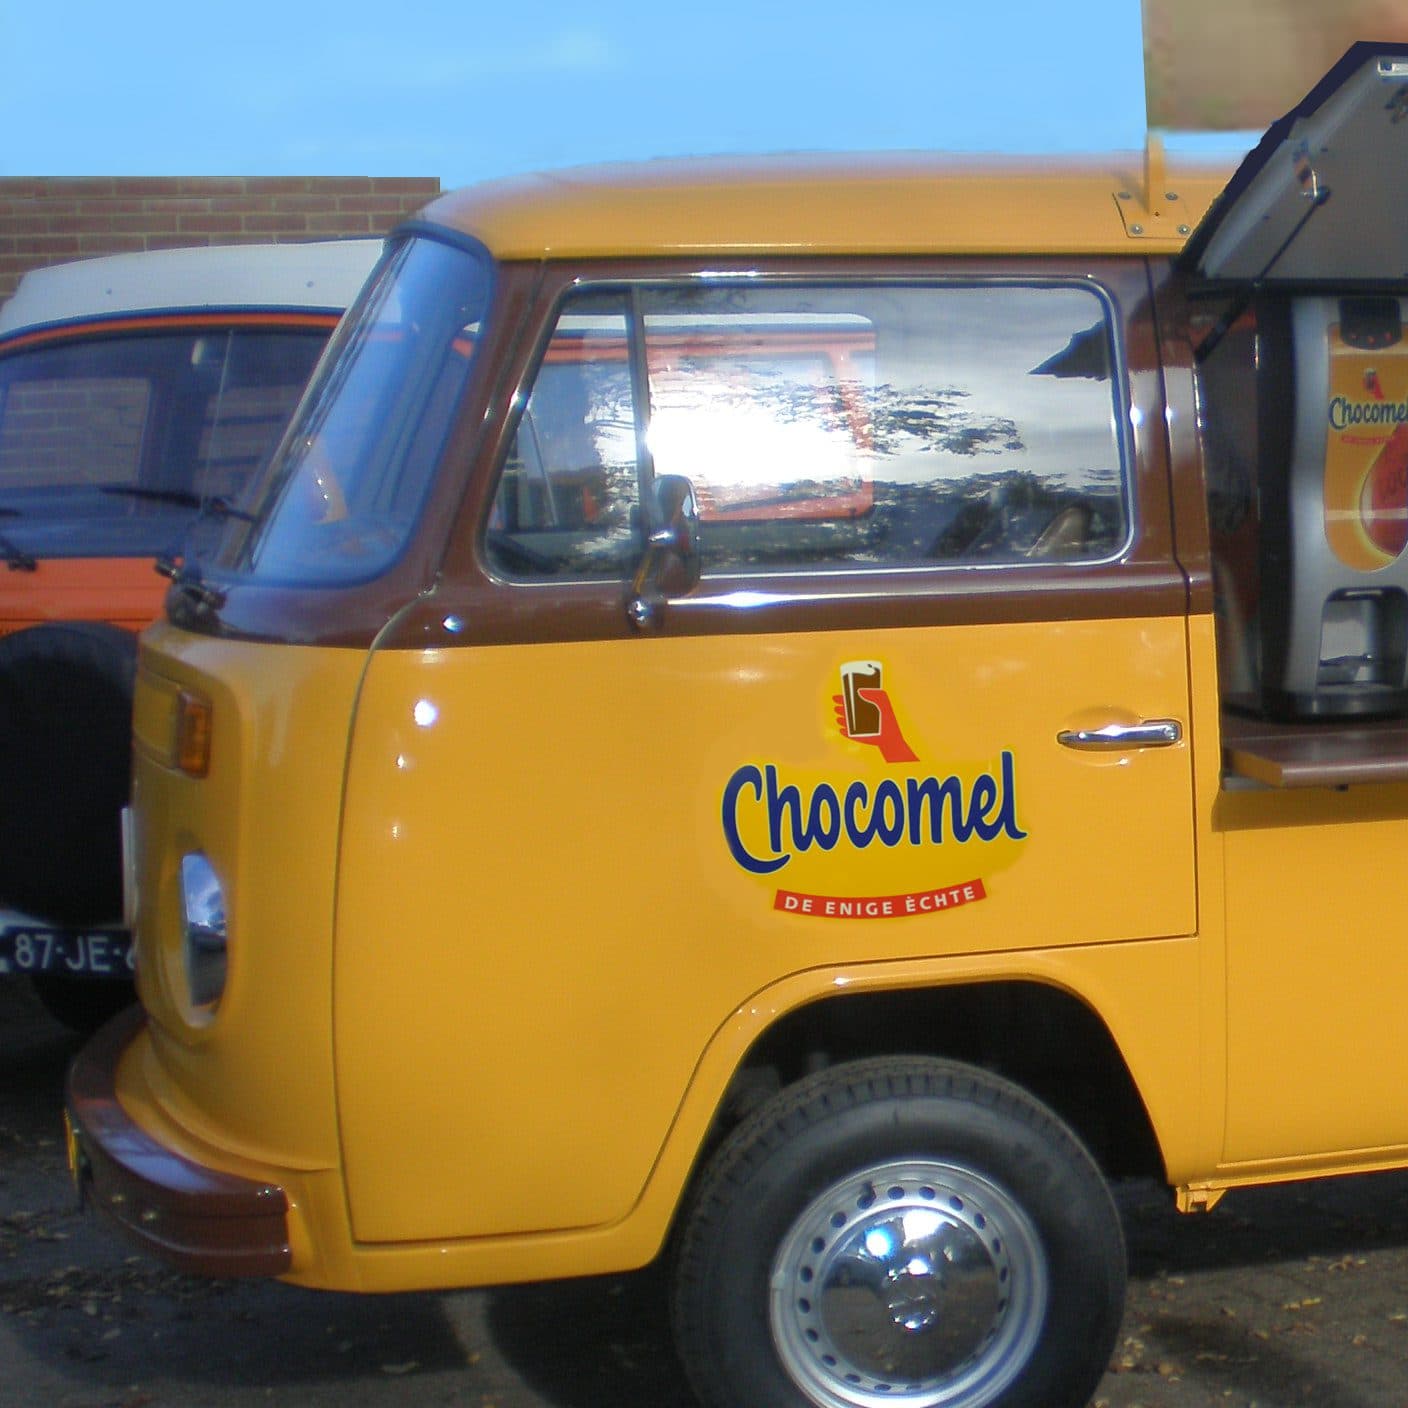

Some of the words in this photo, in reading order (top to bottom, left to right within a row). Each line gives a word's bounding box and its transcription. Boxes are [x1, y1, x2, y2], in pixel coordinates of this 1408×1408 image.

[721, 750, 1028, 874] Chocomel
[784, 895, 813, 912] DE
[825, 901, 893, 916] ENIGE
